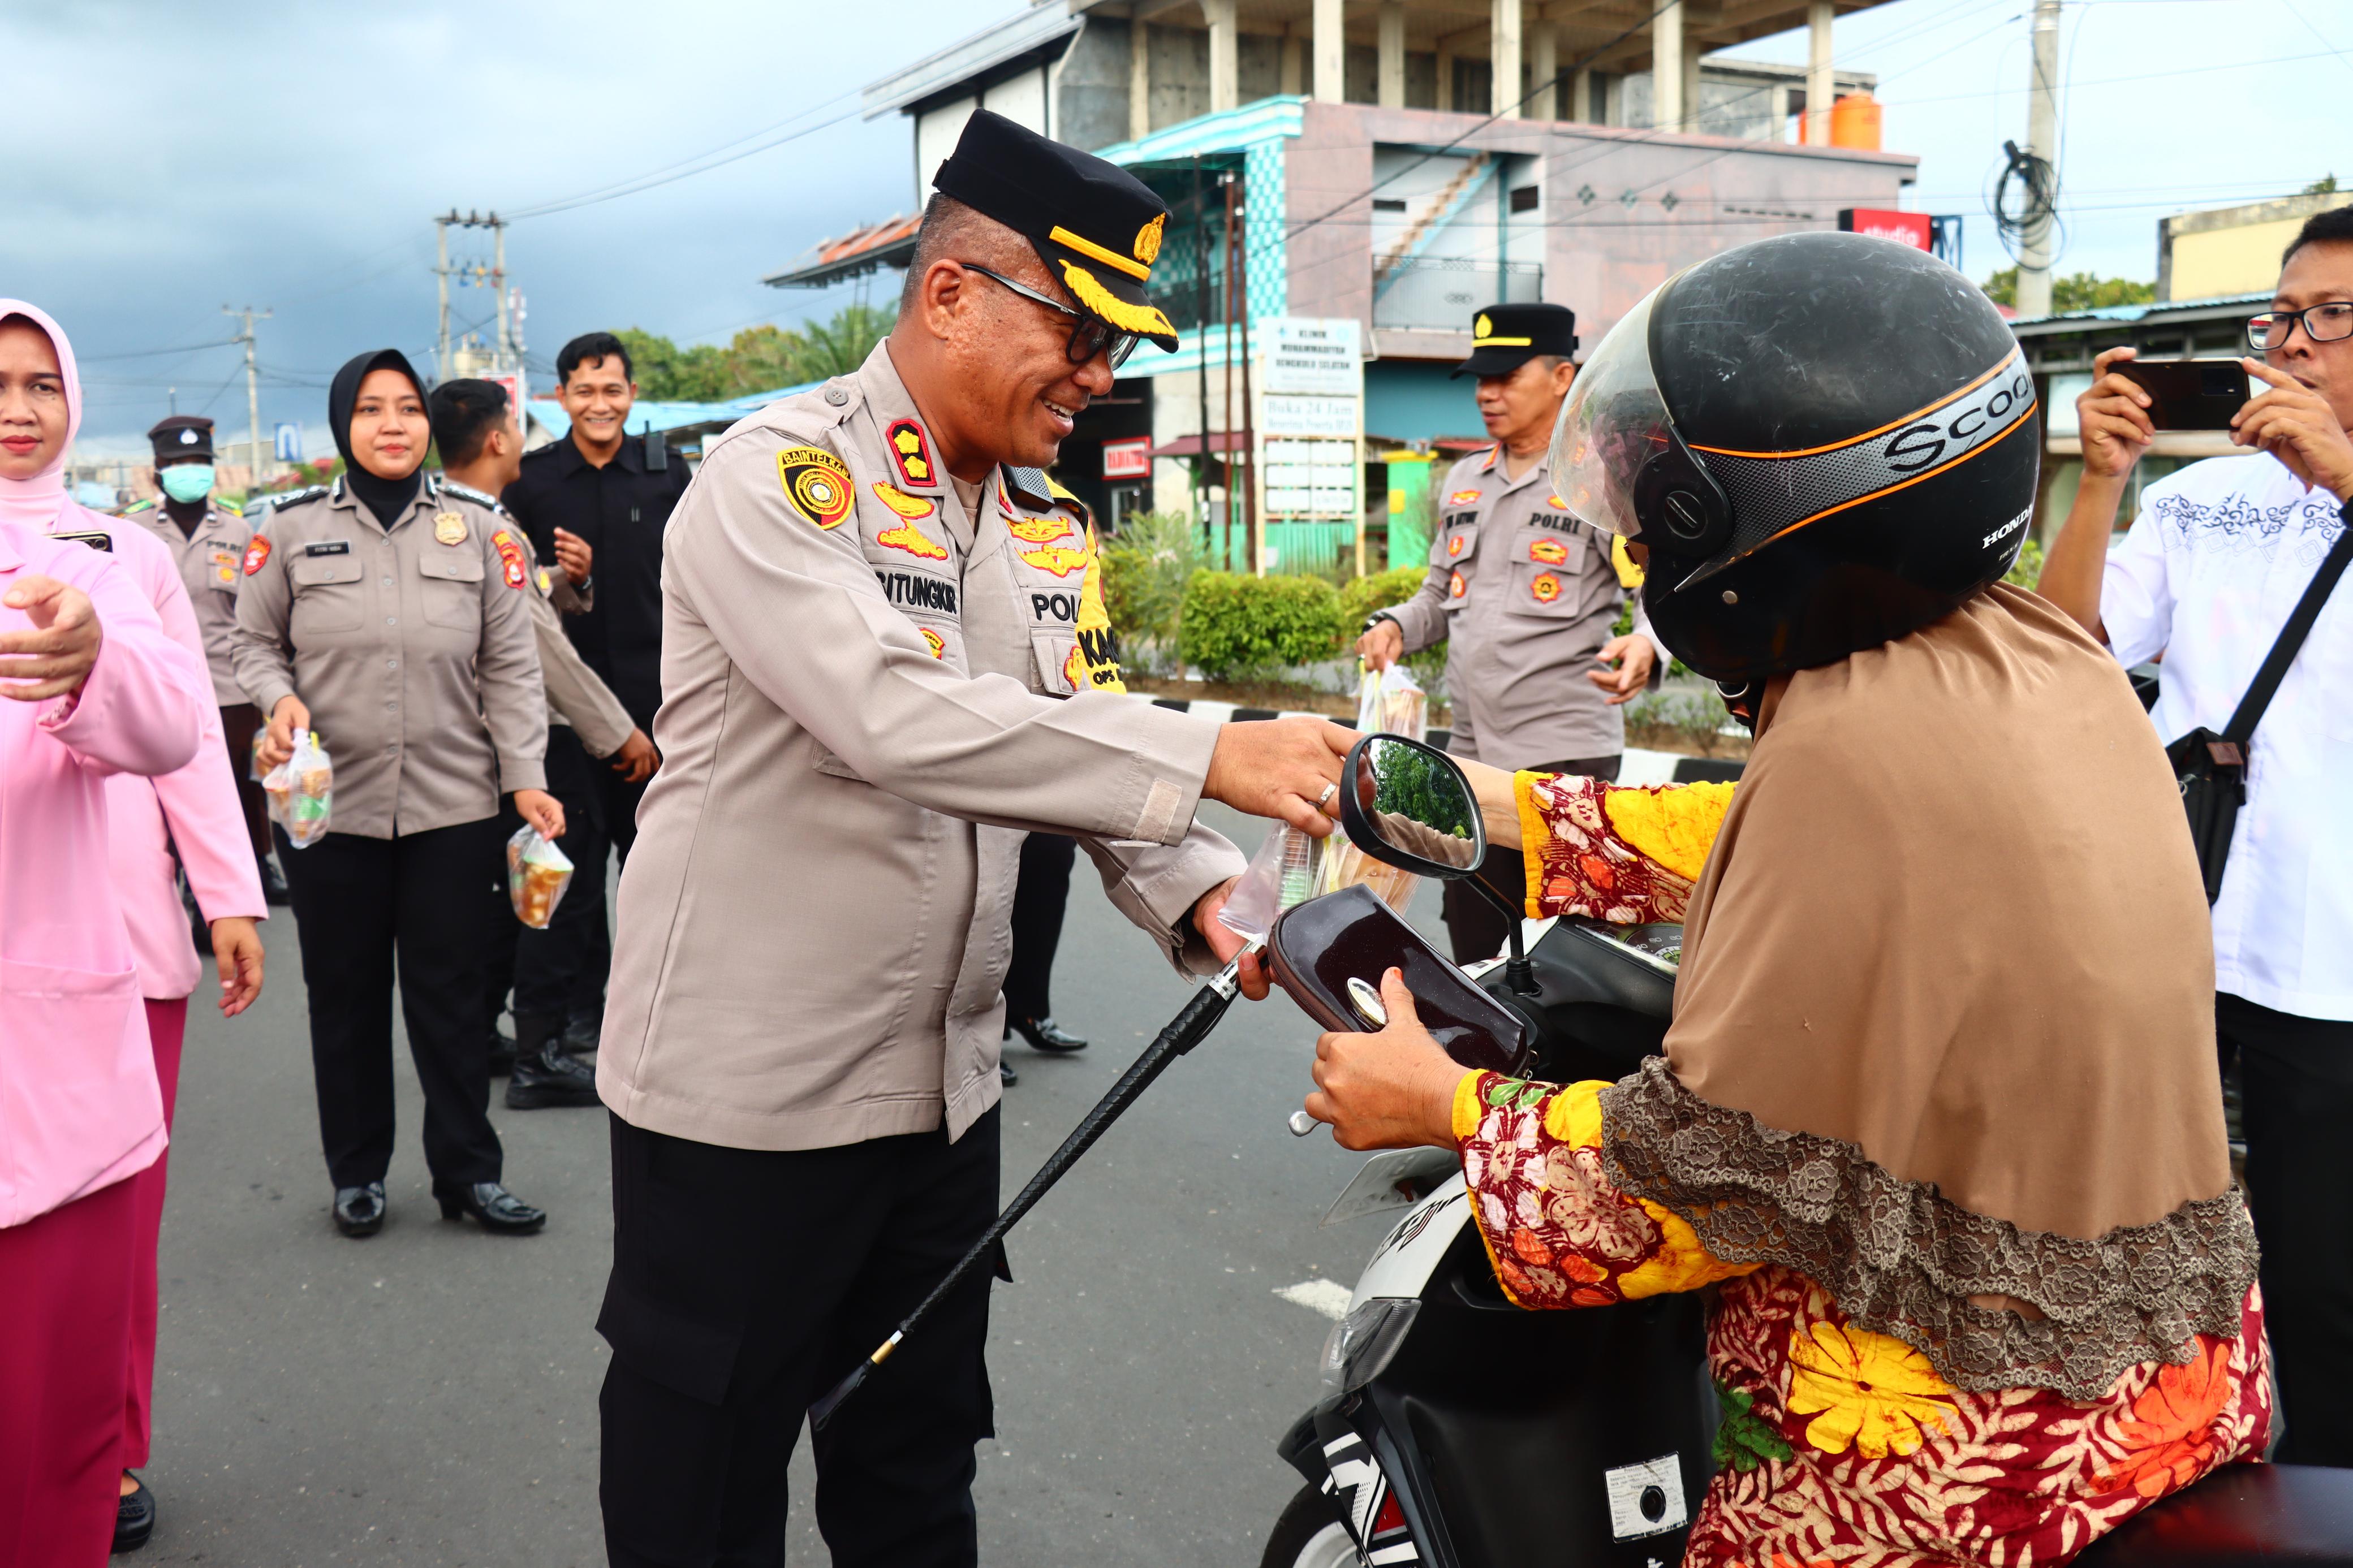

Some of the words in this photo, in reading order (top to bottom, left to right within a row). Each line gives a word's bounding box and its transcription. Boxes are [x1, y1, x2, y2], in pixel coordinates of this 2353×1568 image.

[1863, 223, 1920, 247] studio
[1307, 401, 1322, 414] 24
[1884, 374, 2033, 472] Scoo
[1529, 512, 1581, 534] POLRI
[1982, 503, 2032, 549] HONDA
[1031, 594, 1081, 623] POL
[1093, 669, 1115, 685] OPS
